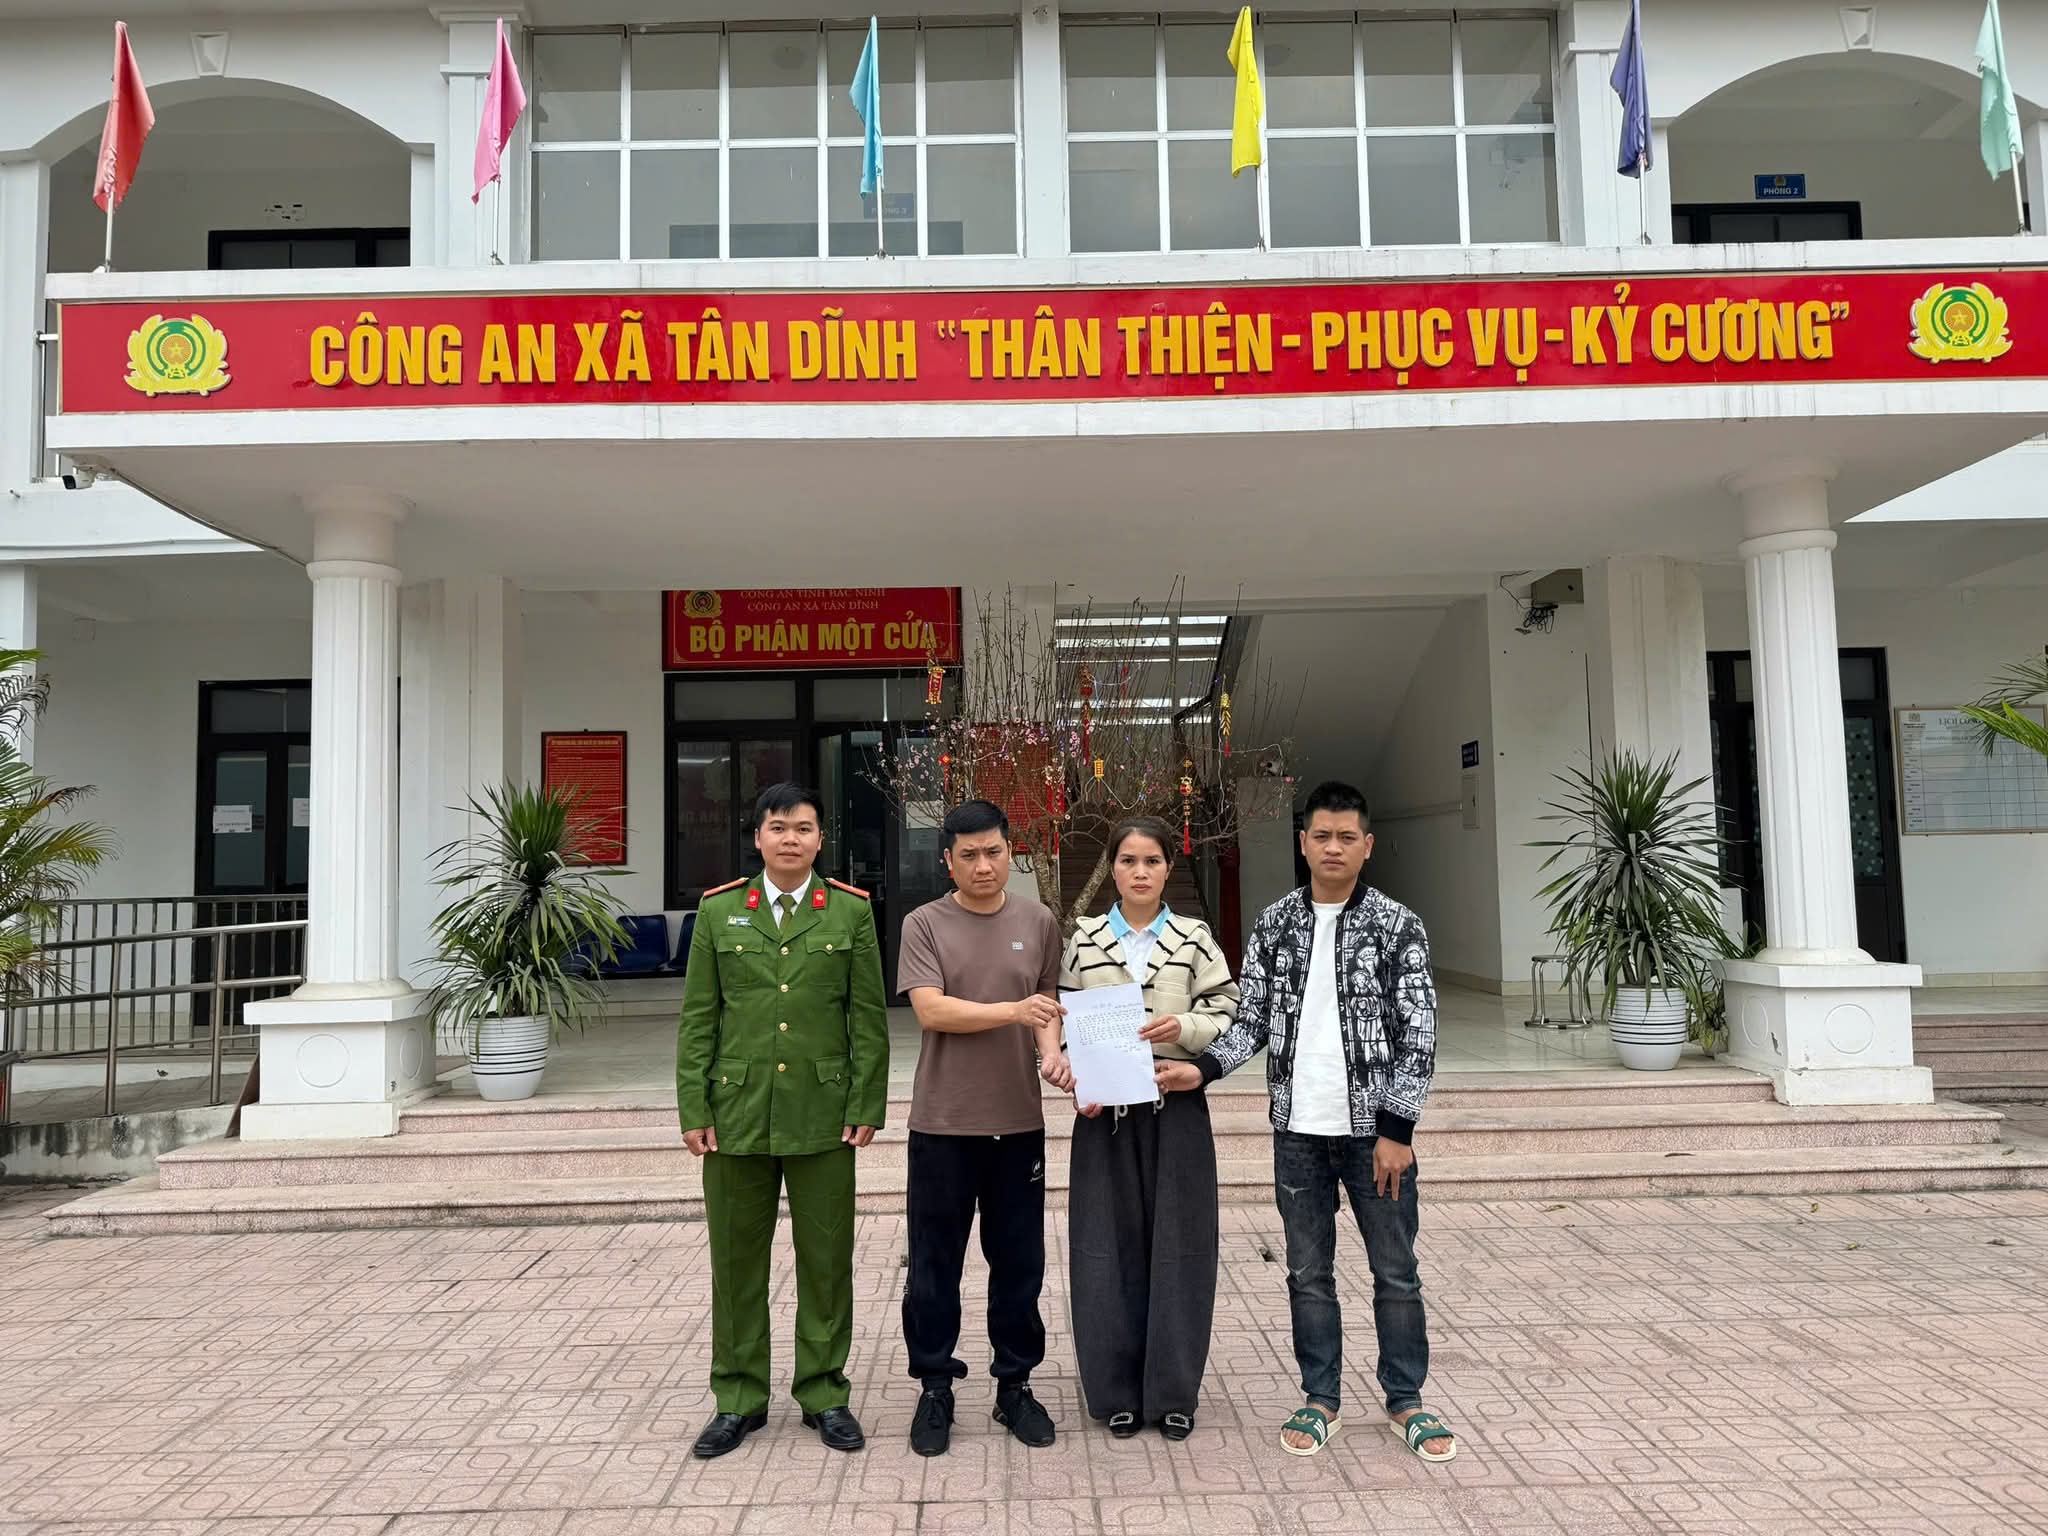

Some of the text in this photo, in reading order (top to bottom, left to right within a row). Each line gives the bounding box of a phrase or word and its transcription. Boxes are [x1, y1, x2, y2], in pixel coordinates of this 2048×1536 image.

[310, 311, 463, 386] CÔNG
[478, 323, 556, 384] AN
[573, 308, 652, 383] XÃ
[667, 307, 770, 382] TÂN
[788, 306, 917, 381] DĨNH
[784, 601, 801, 611] AN
[689, 610, 938, 659] BỘ PHẬN MỘT CỬA
